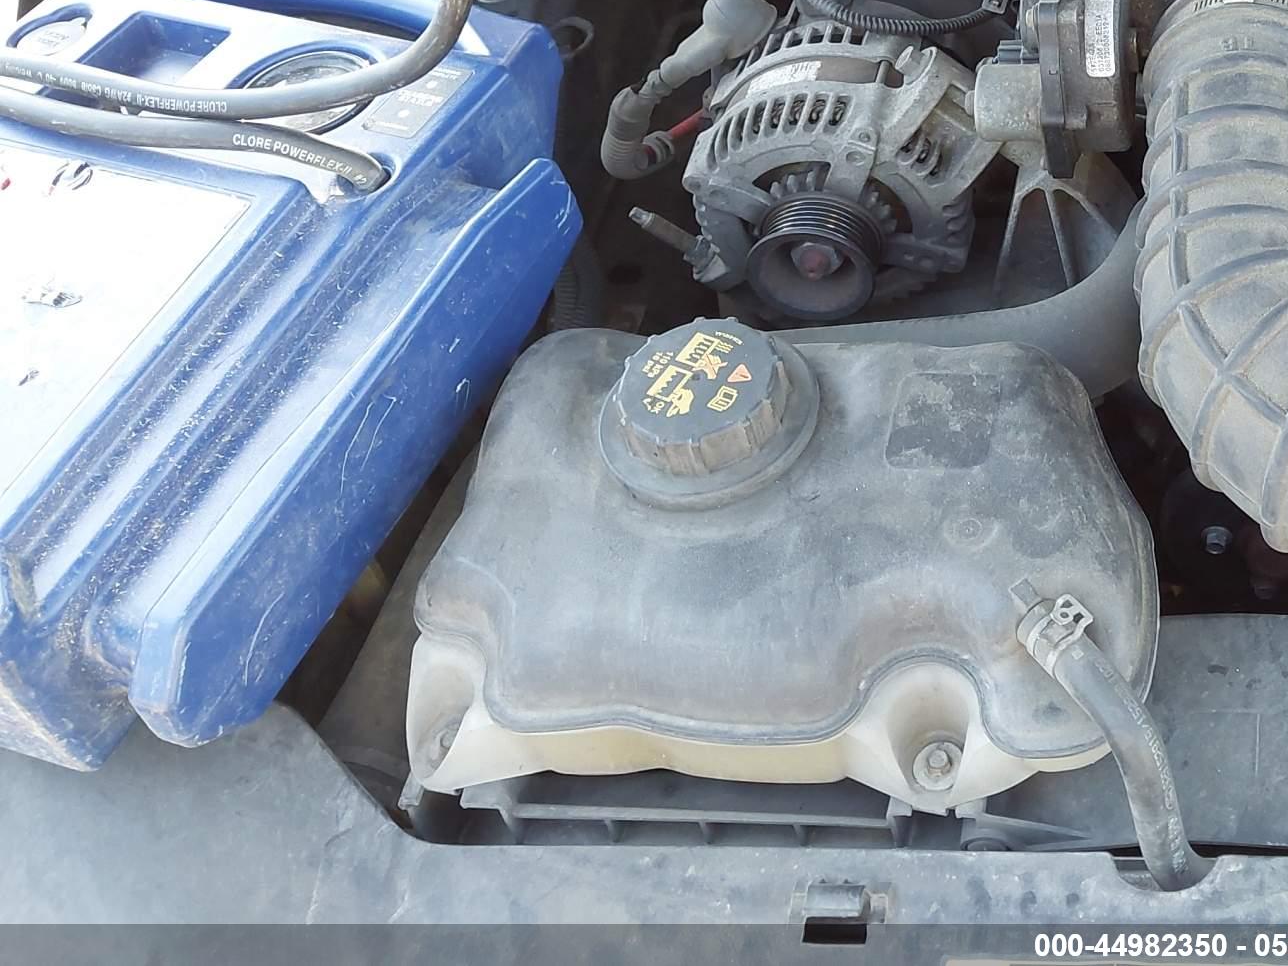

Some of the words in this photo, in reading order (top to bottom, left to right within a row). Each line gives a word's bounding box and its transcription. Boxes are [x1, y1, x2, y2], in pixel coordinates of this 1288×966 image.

[196, 101, 228, 113] CLORE
[232, 133, 272, 151] CLORE
[273, 142, 352, 174] POWERFLEX-II
[660, 351, 674, 365] 110
[647, 362, 664, 378] kPa
[650, 400, 666, 414] OK
